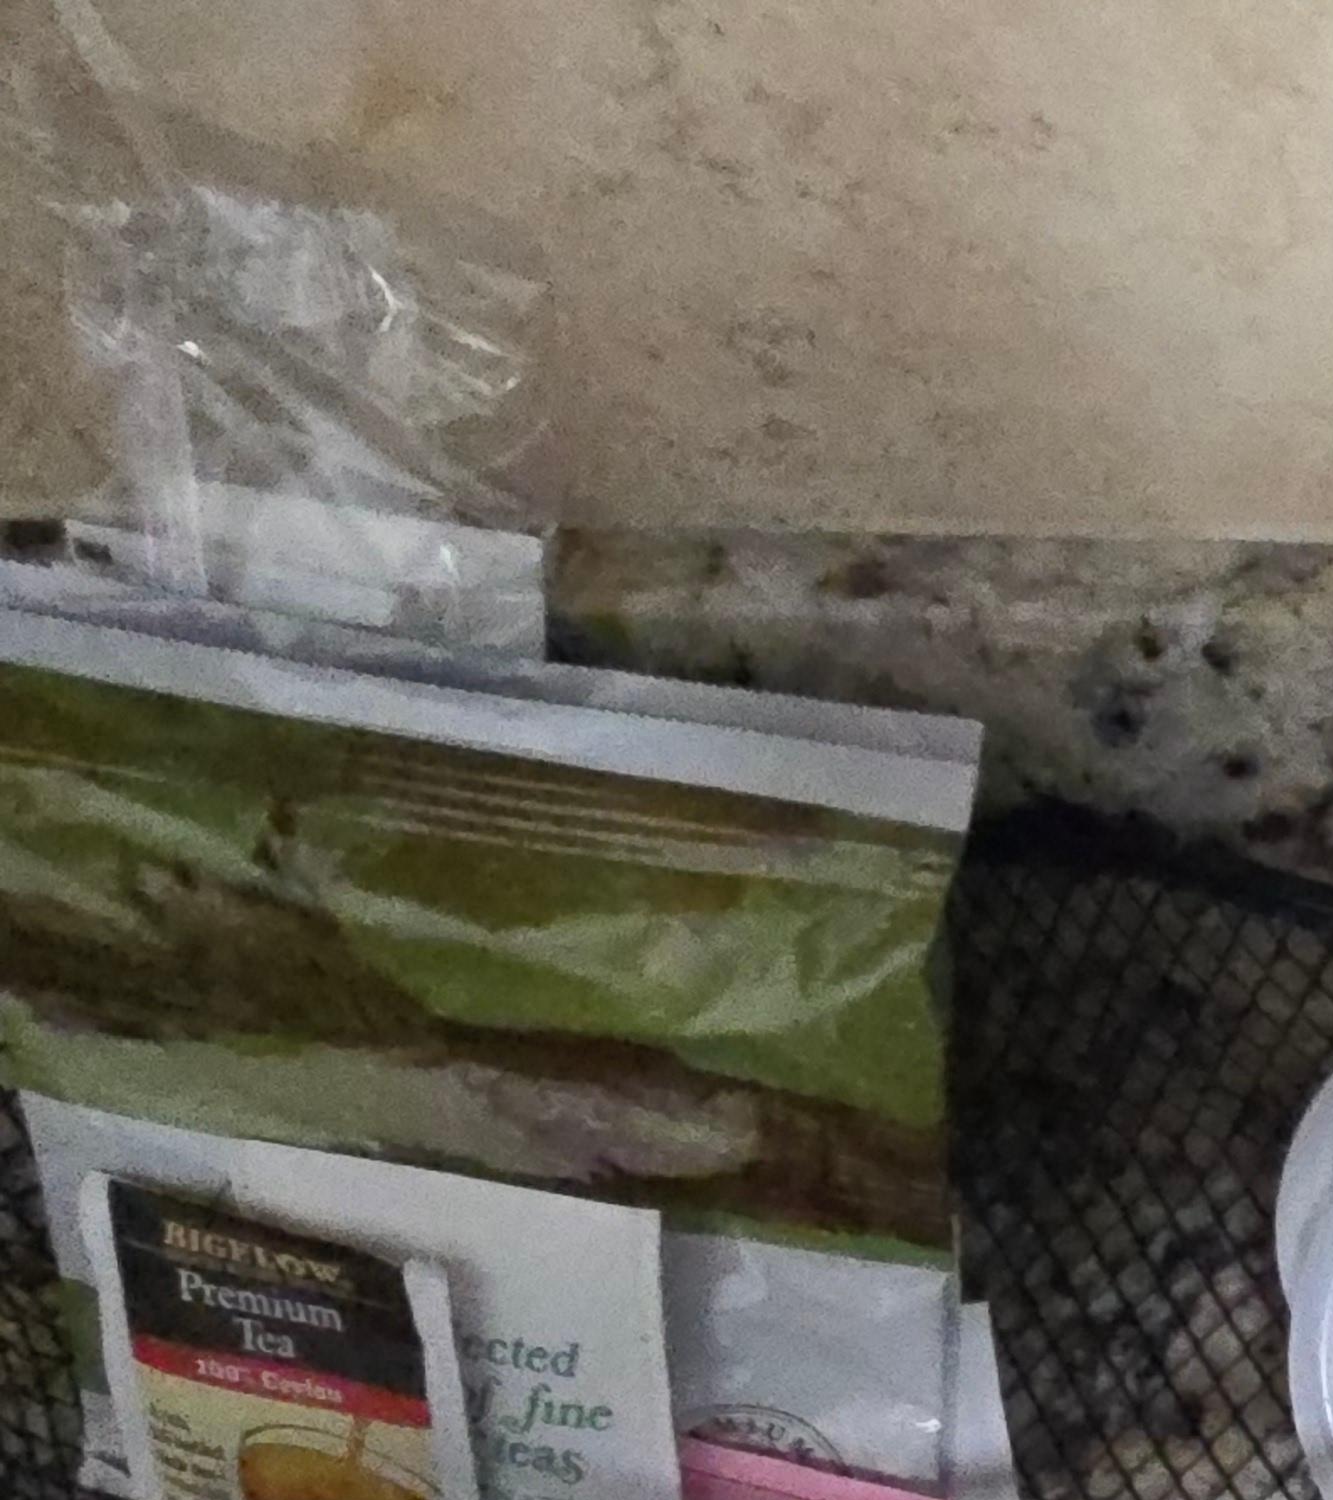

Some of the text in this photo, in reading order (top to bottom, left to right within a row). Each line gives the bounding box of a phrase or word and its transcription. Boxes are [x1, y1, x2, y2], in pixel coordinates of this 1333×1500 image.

[177, 1267, 344, 1334] Premium
[233, 1317, 297, 1359] Tea
[500, 1382, 613, 1433] fine
